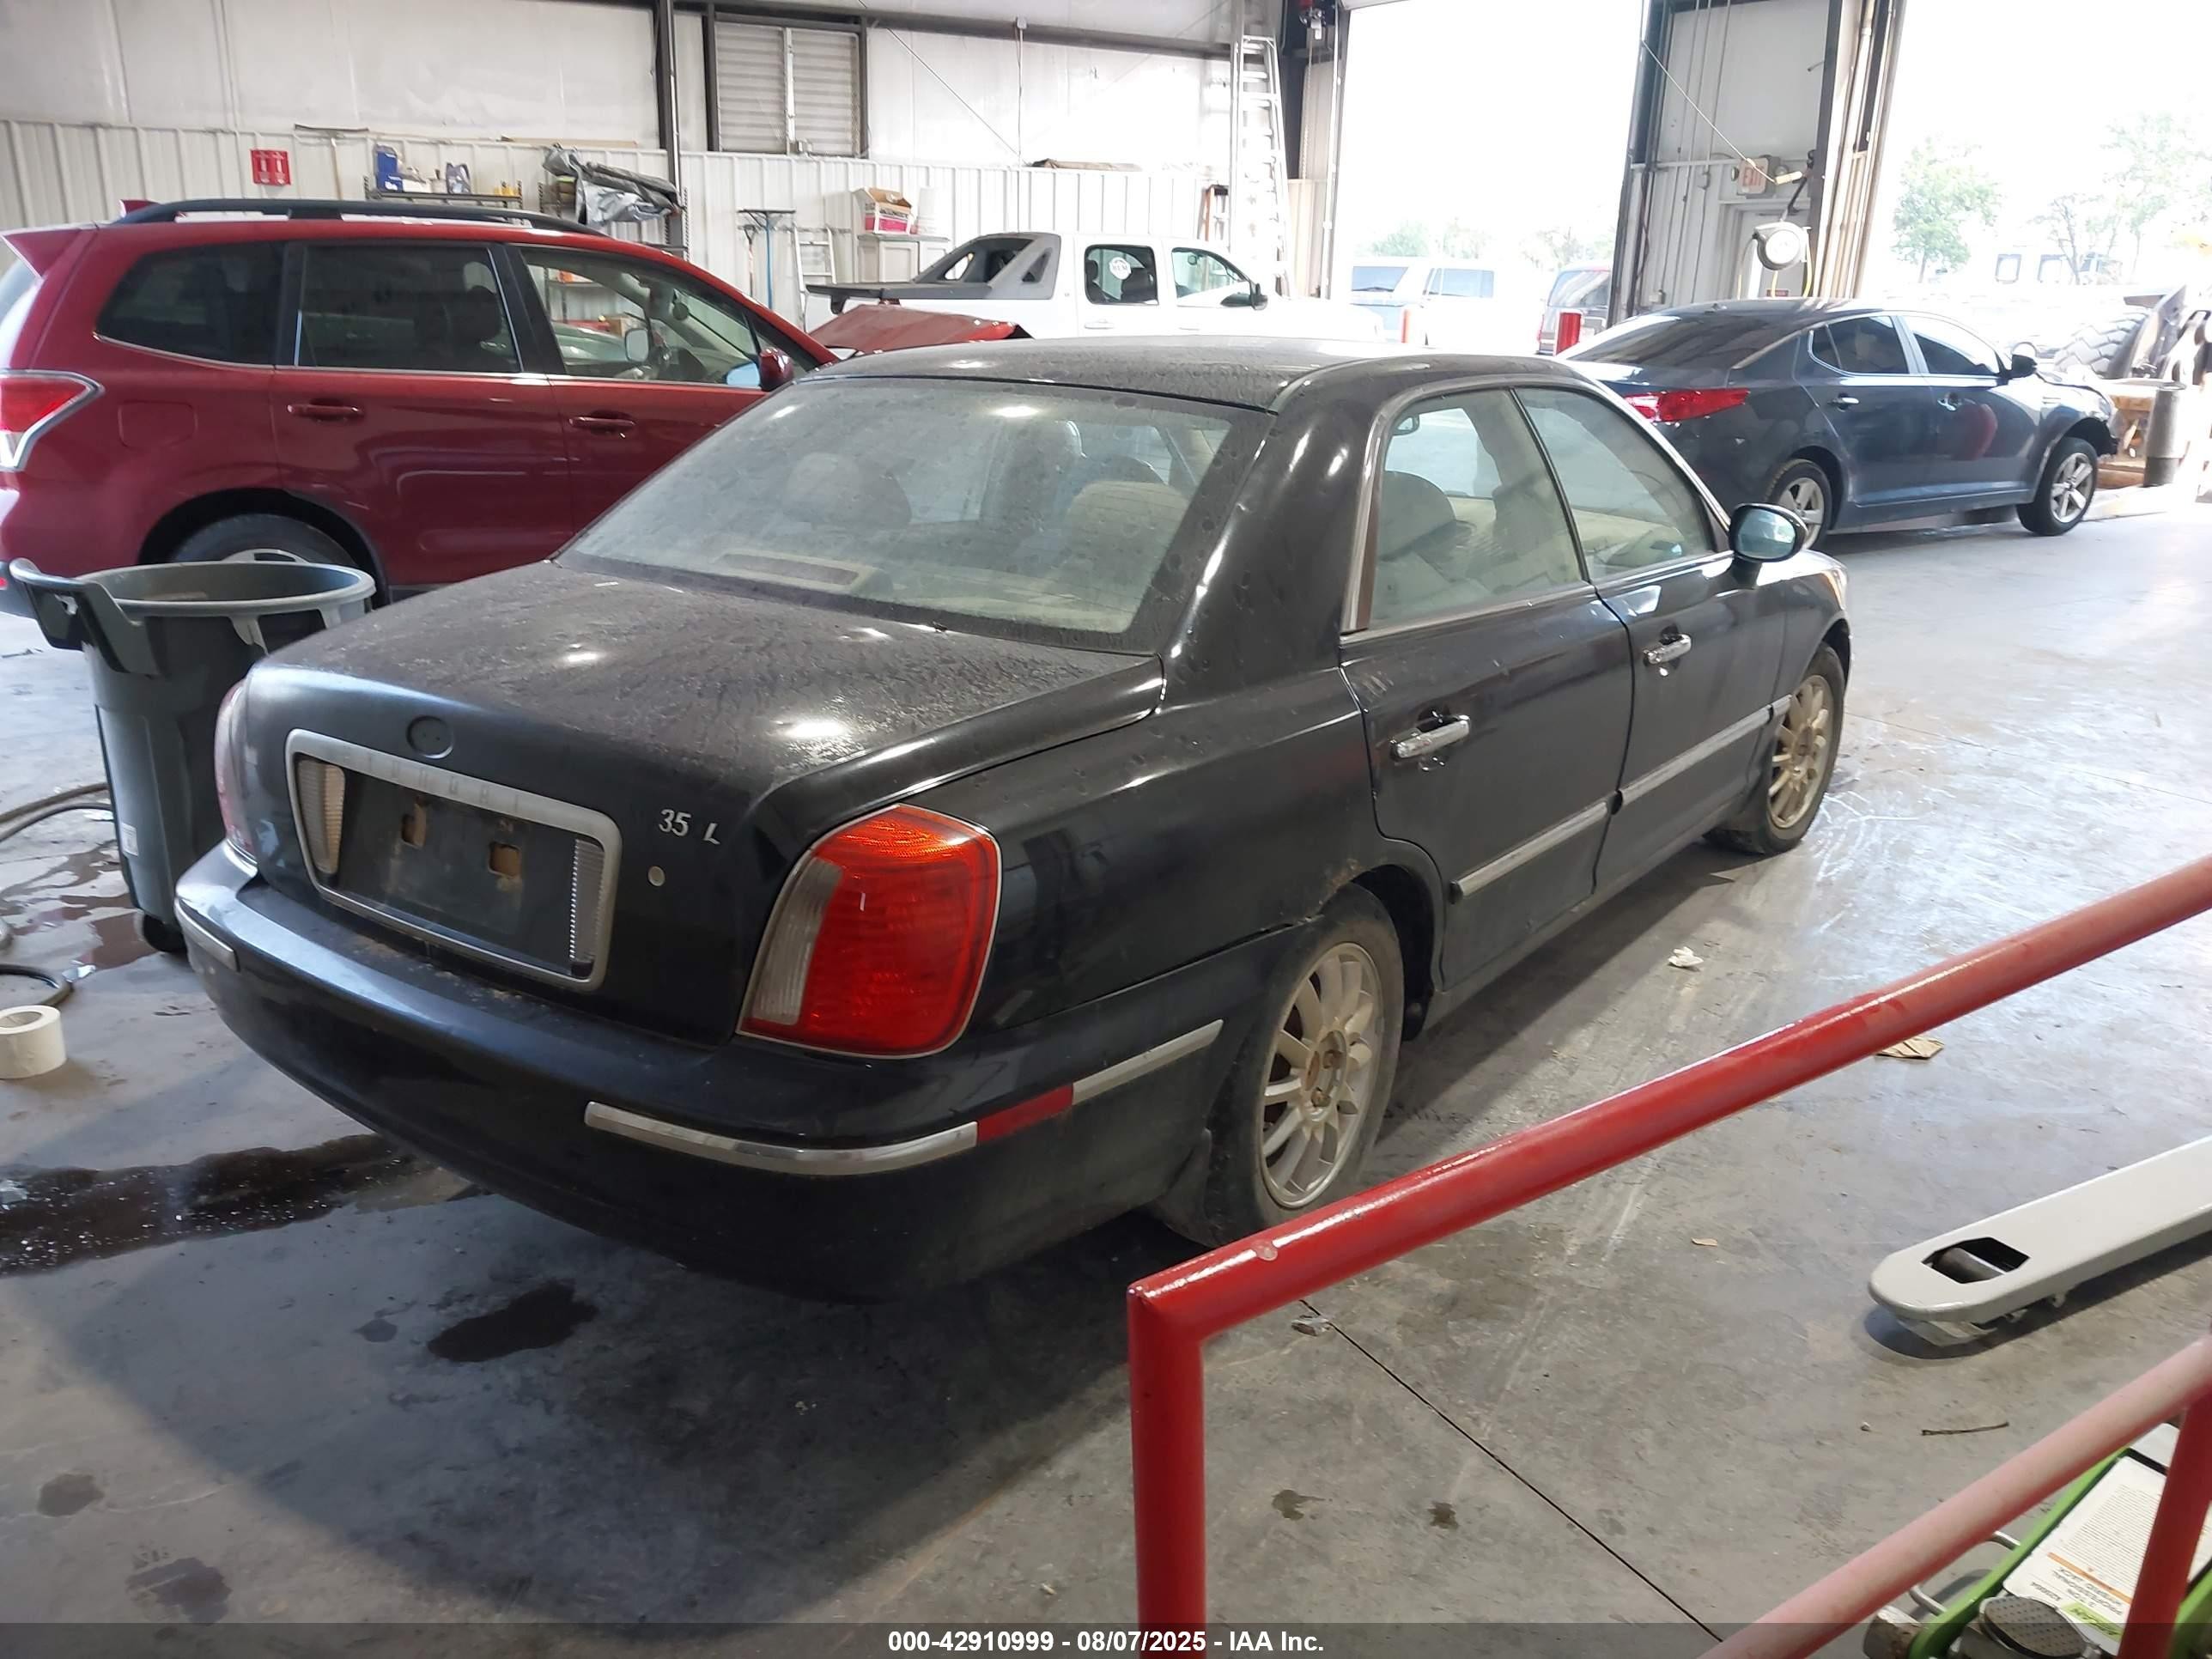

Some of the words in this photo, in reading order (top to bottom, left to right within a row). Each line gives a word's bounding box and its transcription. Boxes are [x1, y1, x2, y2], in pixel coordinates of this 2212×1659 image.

[1742, 164, 1766, 186] EXIT
[659, 809, 691, 836] 35
[703, 823, 720, 845] L
